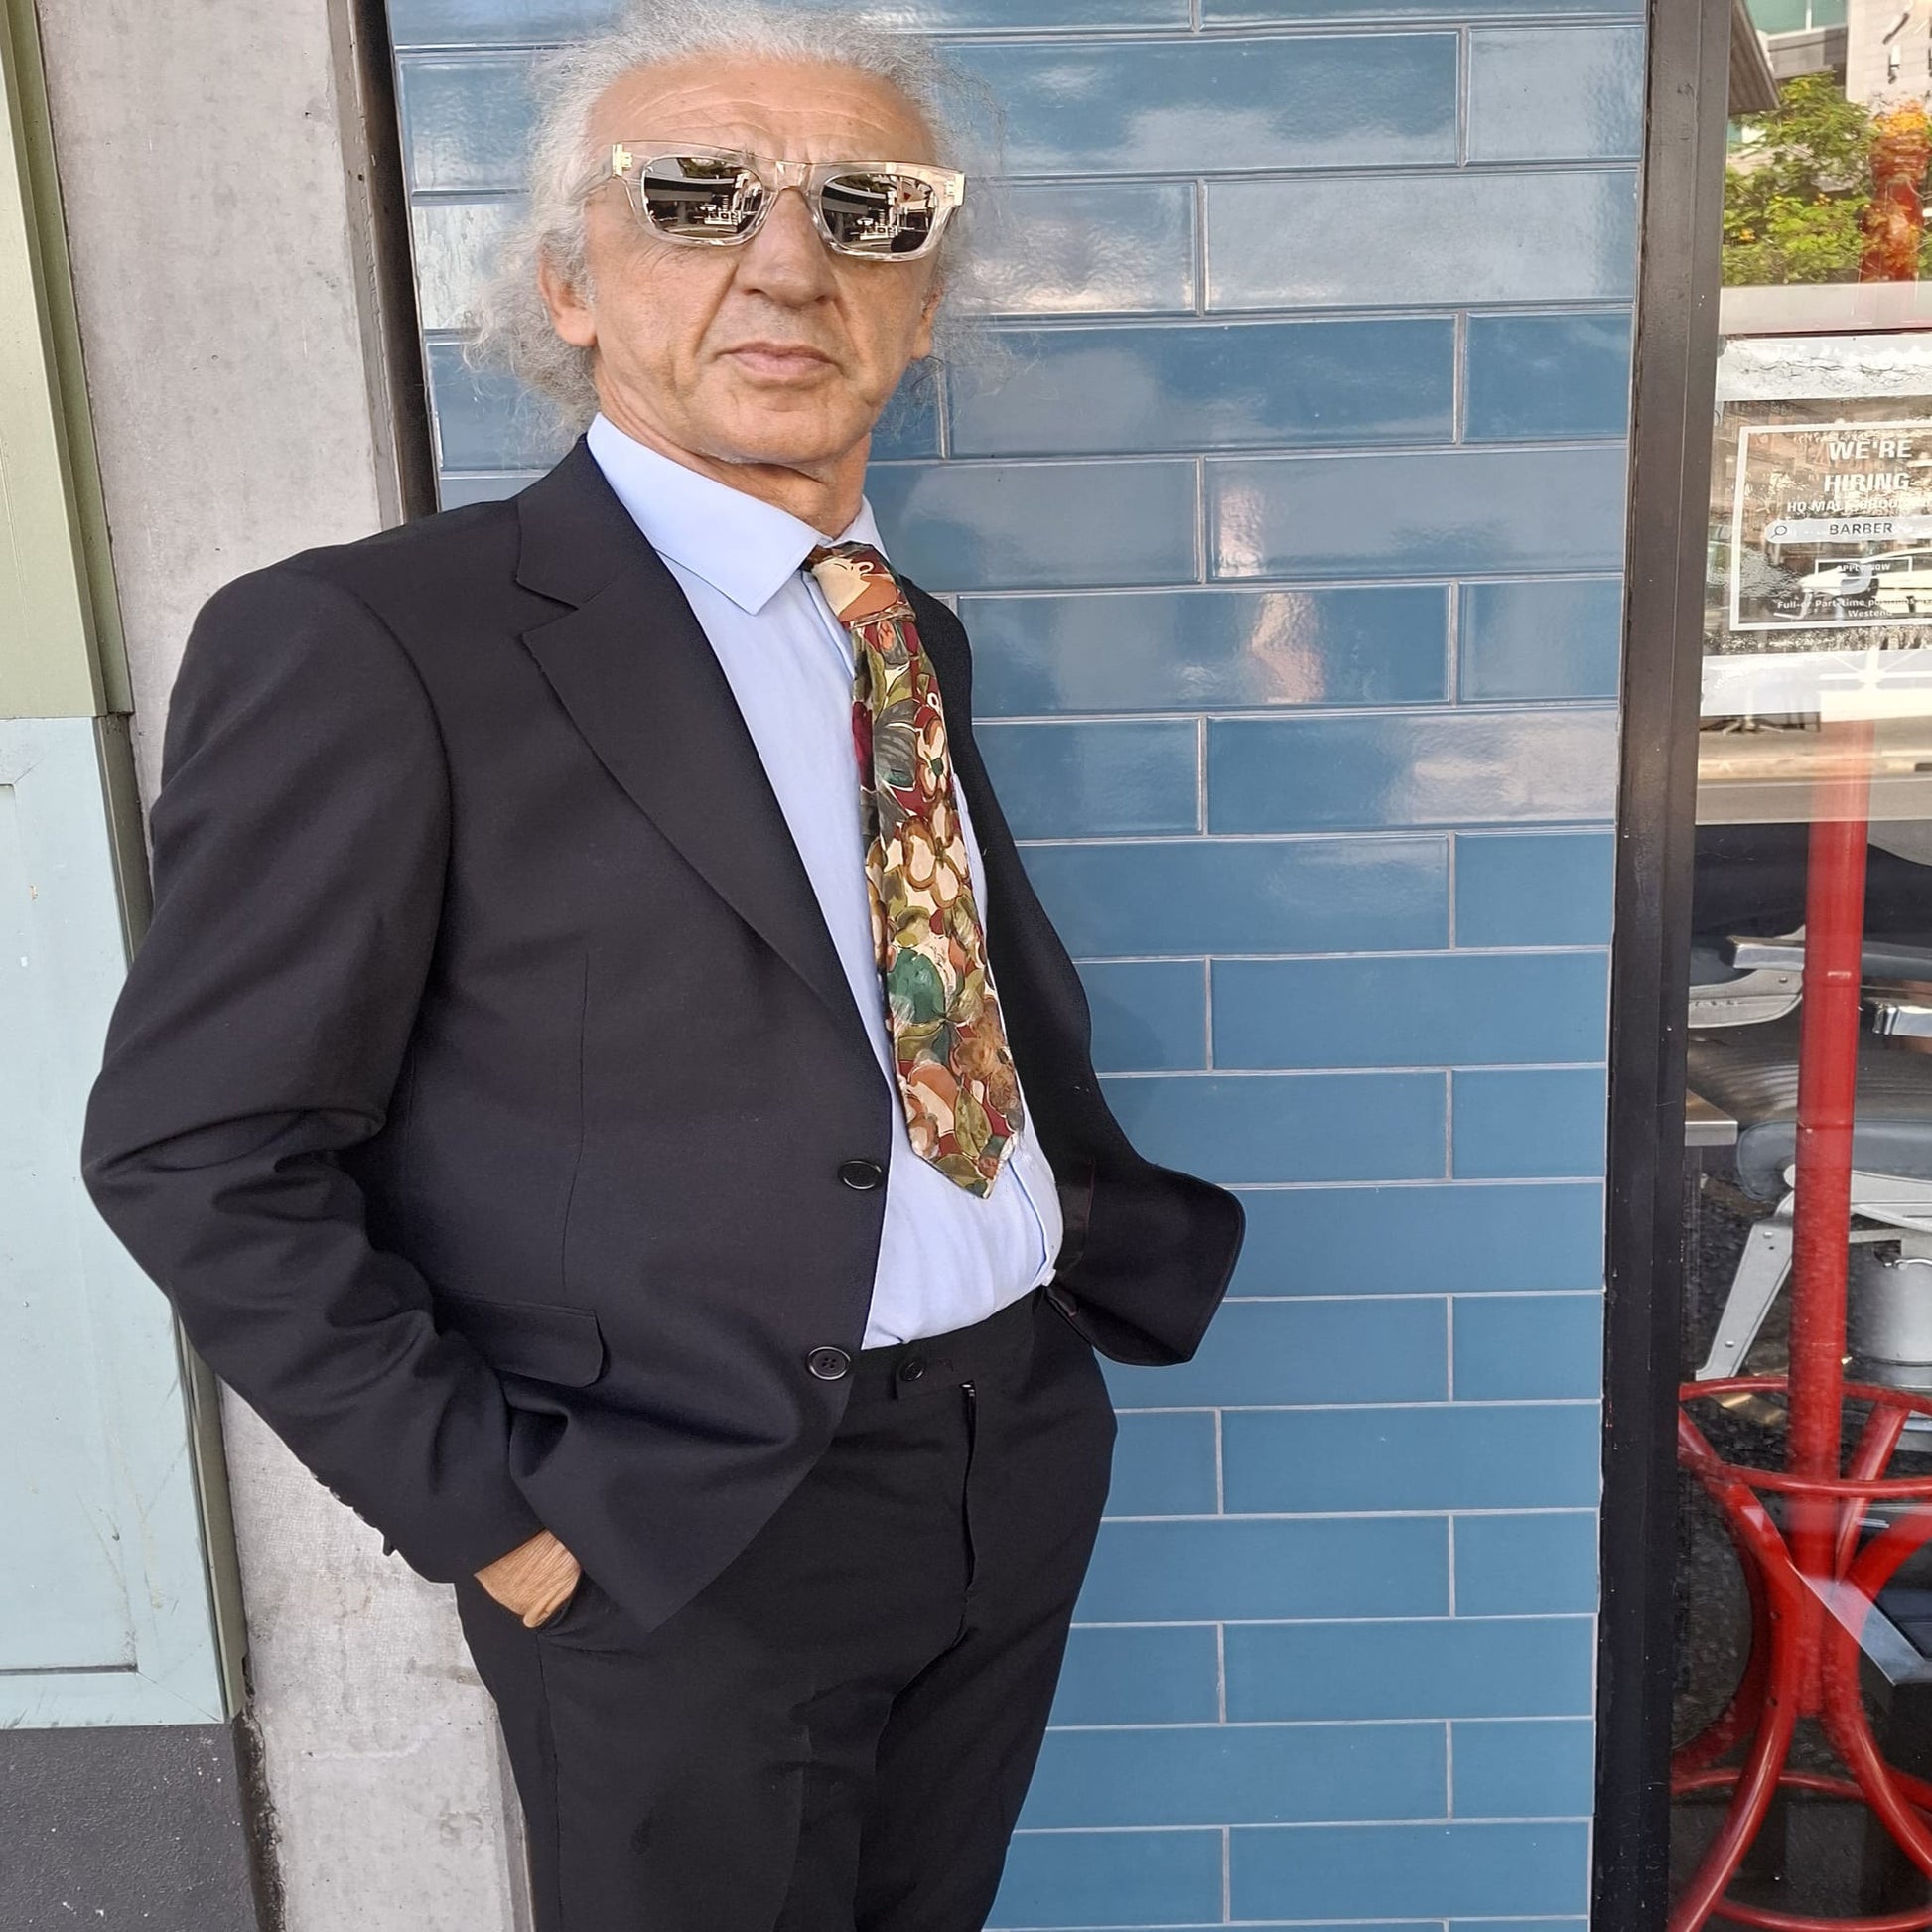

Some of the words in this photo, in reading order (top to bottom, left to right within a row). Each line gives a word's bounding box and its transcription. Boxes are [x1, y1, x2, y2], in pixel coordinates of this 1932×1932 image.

[1828, 439, 1913, 461] WE'RE
[1824, 472, 1910, 492] HIRING
[1787, 501, 1807, 514] HQ
[1829, 523, 1892, 536] BARBER
